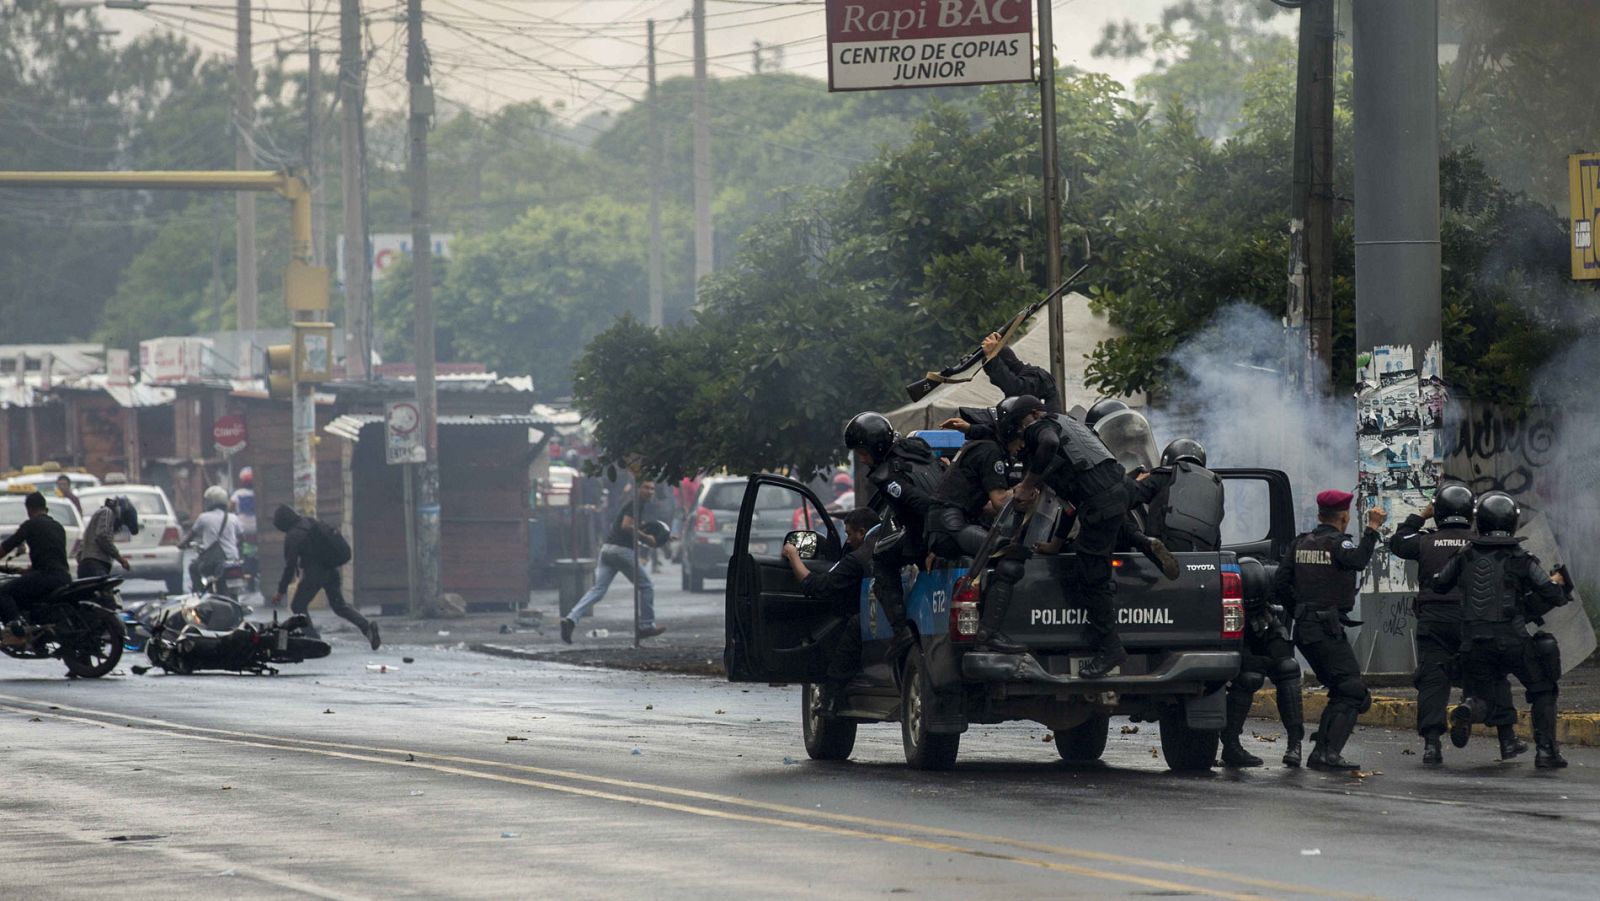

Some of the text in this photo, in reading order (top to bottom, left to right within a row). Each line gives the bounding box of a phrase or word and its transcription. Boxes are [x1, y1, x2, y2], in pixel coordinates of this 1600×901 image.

[841, 0, 1020, 39] Rapi BAC
[840, 39, 1019, 65] CENTRO DE COPIAS
[893, 61, 966, 81] JUNIOR
[1434, 539, 1471, 547] PATRULL
[1295, 550, 1332, 565] PATRULLA
[1031, 607, 1174, 625] POLICIA CIONAL
